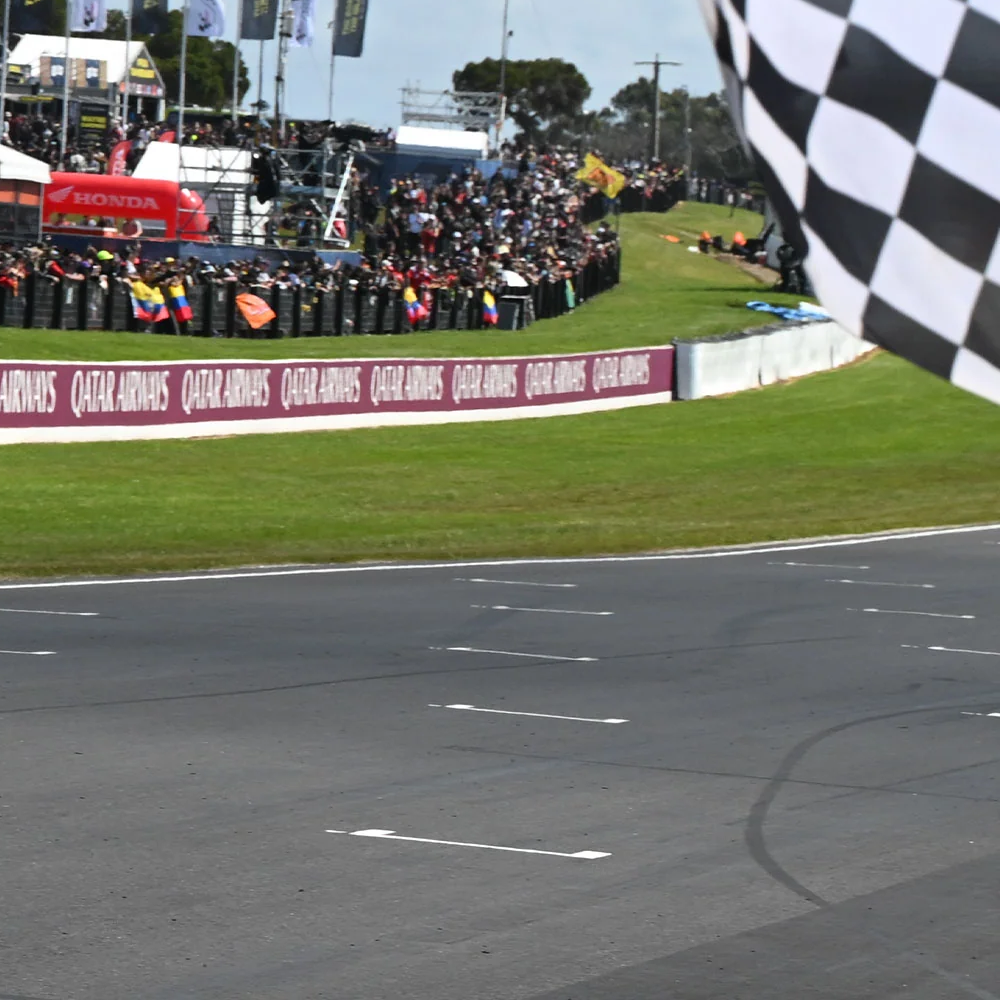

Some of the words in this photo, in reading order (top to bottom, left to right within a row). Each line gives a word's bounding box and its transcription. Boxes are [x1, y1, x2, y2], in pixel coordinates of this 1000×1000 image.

[73, 192, 160, 210] HONDA
[71, 370, 115, 418] QATAR
[115, 371, 170, 411] AIRWAYS
[181, 369, 223, 415] QATAR
[221, 368, 271, 408] AIRWAYS
[281, 367, 318, 410] QATAR
